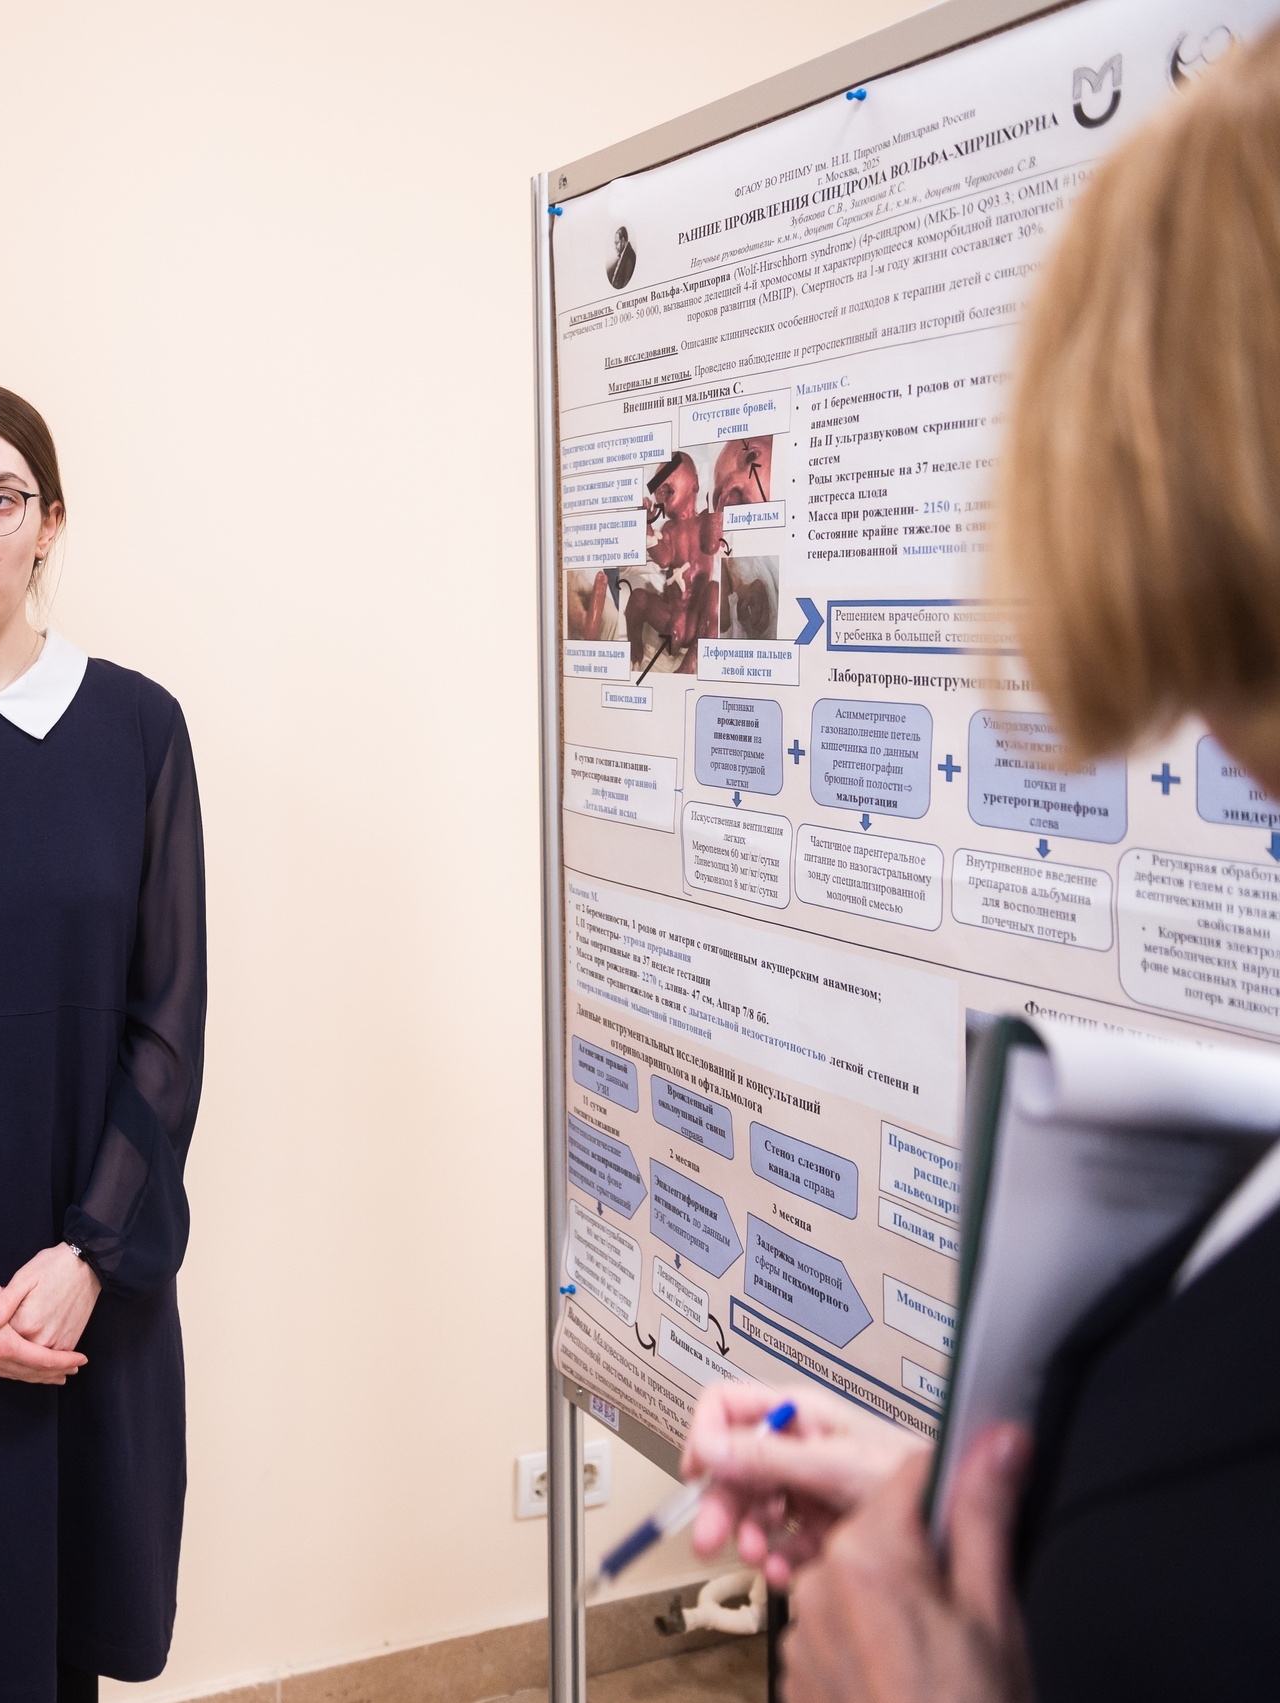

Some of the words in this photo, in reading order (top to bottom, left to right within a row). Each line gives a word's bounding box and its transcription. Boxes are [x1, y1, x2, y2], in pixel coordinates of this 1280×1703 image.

[764, 173, 778, 189] ВО
[779, 162, 813, 184] РНИМУ
[815, 162, 828, 173] им.
[831, 151, 851, 168] Н.И.
[853, 142, 890, 161] Пирогова
[942, 109, 976, 128] России
[678, 218, 722, 245] РАННИЕ
[724, 194, 809, 232] ПРОЯВЛЕНИЯ
[812, 169, 888, 207] СИНДРОМА
[890, 111, 1059, 181] ВОЛЬФА-ХИРШХОРНА
[825, 168, 860, 184] Москва,
[862, 157, 880, 174] 2025
[616, 295, 648, 310] Синдром
[650, 274, 731, 301] Вольфа-Хиршхорна
[733, 254, 808, 282] (Wolf-Hirschhorn
[810, 236, 856, 260] syndrome)
[924, 204, 974, 229] (МКБ-10
[663, 297, 702, 313] вызванное
[704, 284, 742, 304] делецией
[743, 280, 758, 293] 4-й
[760, 270, 812, 290] хромосомы
[814, 268, 820, 276] и
[822, 240, 914, 273] характеризующееся
[916, 217, 992, 245] коморбидной
[995, 199, 1064, 225] патологией
[687, 306, 719, 322] пороков
[720, 298, 756, 316] развития
[758, 287, 798, 307] (МВПР).
[802, 274, 854, 295] Смертность
[856, 271, 868, 281] на
[887, 259, 910, 273] году
[912, 250, 948, 266] жизни
[950, 233, 1014, 255] составляет
[604, 356, 622, 369] Цель
[624, 344, 678, 363] исследования.
[680, 335, 719, 350] Описание
[720, 324, 775, 342] клинических
[777, 308, 838, 331] особенностей
[840, 309, 846, 317] и
[848, 296, 890, 313] подходов
[893, 293, 900, 302] к
[902, 284, 946, 300] терапии
[949, 273, 982, 292] детей
[608, 378, 652, 392] Материалы
[653, 376, 659, 384] и
[660, 370, 692, 383] методы.
[693, 361, 736, 378] Проведено
[738, 351, 791, 367] наблюдение
[793, 349, 799, 357] и
[802, 327, 878, 356] ретроспективный
[881, 322, 917, 336] анализ
[920, 309, 966, 328] историй
[796, 381, 838, 395] Мальчик
[840, 377, 850, 388] С.
[811, 402, 822, 411] от
[824, 398, 828, 409] 1
[830, 391, 902, 410] беременности,
[907, 385, 912, 396] 1
[916, 383, 950, 397] родов
[953, 380, 966, 389] от
[623, 396, 665, 413] Внешний
[666, 397, 683, 408] вид
[685, 388, 730, 405] мальчика
[733, 383, 744, 395] С.
[692, 407, 741, 421] Отсутствие
[743, 400, 777, 416] бровей,
[717, 423, 749, 437] ресниц
[811, 415, 860, 429] анамнезом
[809, 437, 822, 448] На
[835, 427, 918, 448] ультразвуковом
[922, 418, 987, 434] скрининге
[809, 455, 840, 466] систем
[809, 473, 833, 485] Роды
[835, 469, 895, 483] экстренные
[898, 467, 912, 476] на
[915, 463, 928, 474] 37
[808, 491, 855, 504] дистресса
[858, 489, 888, 499] плода
[727, 512, 779, 525] Лагофтальм
[809, 511, 838, 522] Масса
[841, 511, 859, 523] при
[923, 502, 950, 514] 2150
[808, 529, 858, 540] Состояние
[862, 525, 899, 540] крайне
[902, 525, 950, 535] тяжелое
[807, 544, 898, 561] генерализованной
[835, 610, 885, 622] Решением
[888, 610, 950, 625] врачебного
[835, 633, 841, 644] у
[844, 630, 883, 644] ребенка
[886, 633, 891, 641] в
[894, 630, 941, 642] большей
[703, 648, 754, 661] Деформация
[756, 652, 792, 661] пальцев
[721, 666, 745, 676] левой
[746, 669, 772, 677] кисти
[835, 708, 906, 723] Асимметричное
[821, 726, 889, 738] газонаполнение
[890, 731, 921, 741] петель
[821, 743, 868, 753] кишечника
[870, 746, 881, 754] по
[883, 748, 919, 758] данным
[824, 771, 864, 786] брюшной
[832, 761, 903, 776] рентгенографии
[1024, 781, 1057, 791] почки
[1059, 783, 1066, 791] и
[836, 794, 898, 808] мальротация
[1029, 819, 1059, 829] слева
[966, 854, 1043, 877] Внутривенное
[1045, 870, 1098, 887] введение
[669, 932, 695, 947] матери
[697, 939, 701, 947] с
[702, 941, 757, 964] отягощенным
[760, 959, 819, 983] акушерским
[823, 977, 882, 1003] анамнезом;
[691, 989, 700, 1001] 47
[741, 1026, 826, 1061] недостаточностью
[829, 1056, 863, 1074] легкой
[867, 1069, 909, 1091] степени
[912, 1086, 920, 1095] и
[676, 1049, 736, 1078] исследований
[737, 1073, 744, 1083] и
[746, 1078, 821, 1114] консультаций
[764, 1140, 795, 1162] Стеноз
[798, 1156, 841, 1181] слезного
[768, 1163, 801, 1184] канала
[803, 1178, 835, 1199] справа
[772, 1202, 777, 1214] 3
[779, 1210, 812, 1232] месяца
[892, 1214, 935, 1241] Полная
[755, 1255, 780, 1275] сферы
[756, 1234, 795, 1265] Задержка
[797, 1260, 843, 1290] моторной
[753, 1276, 793, 1303] развития
[742, 1315, 761, 1339] При
[763, 1331, 829, 1374] стандартном
